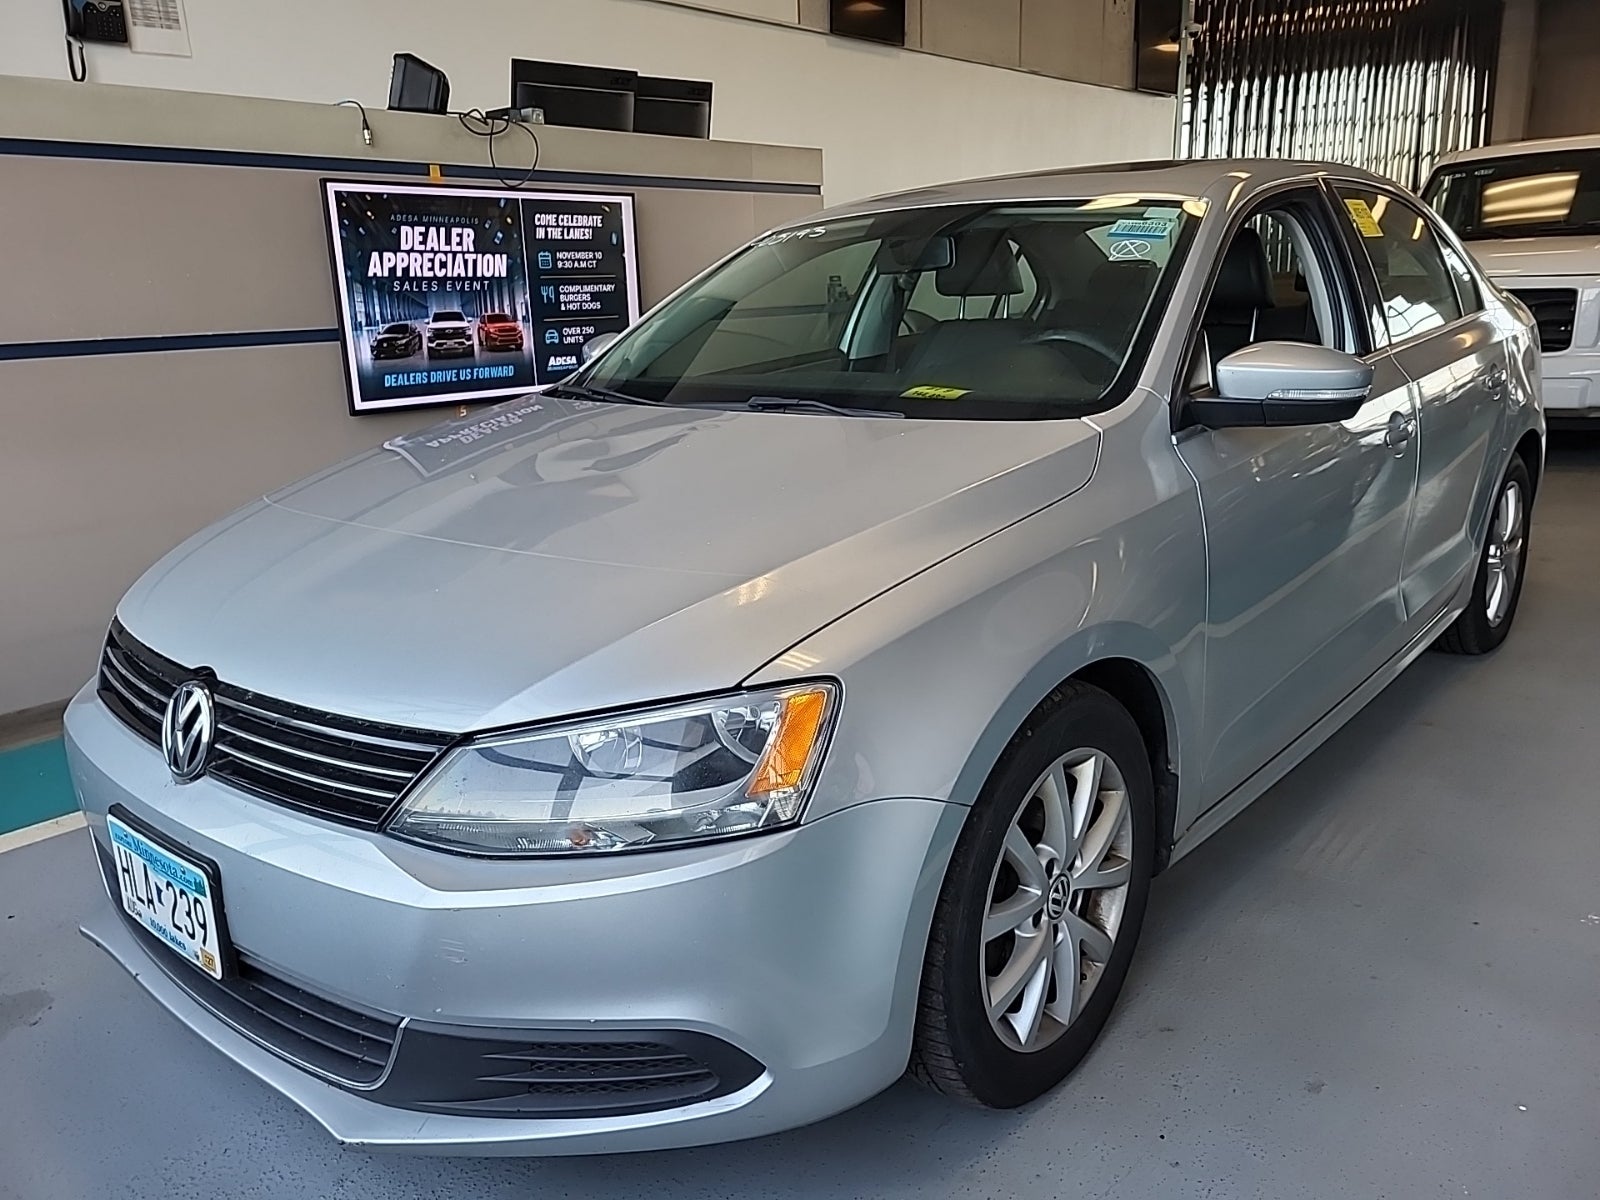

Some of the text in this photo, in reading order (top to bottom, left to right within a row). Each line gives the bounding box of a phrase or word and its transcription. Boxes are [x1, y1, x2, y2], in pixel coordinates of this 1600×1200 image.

[390, 214, 479, 224] ADESA MINNEAPOLIS
[534, 213, 603, 227] COME CELEBRATE
[400, 225, 475, 252] DEALER
[536, 227, 593, 240] IN THE LANES!
[556, 251, 603, 260] NOVEMBER 10
[367, 251, 508, 278] APPRECIATION
[557, 260, 573, 269] 9:30
[393, 280, 490, 292] SALES EVENT
[559, 284, 615, 293] COMPLIMENTARY
[560, 294, 591, 302] BURGERS
[566, 303, 580, 311] HOT
[582, 302, 601, 310] DOGS
[562, 326, 595, 336] OVER 250
[563, 336, 584, 345] UNITS
[384, 365, 515, 387] DEALERS DRIVE US FORWARD
